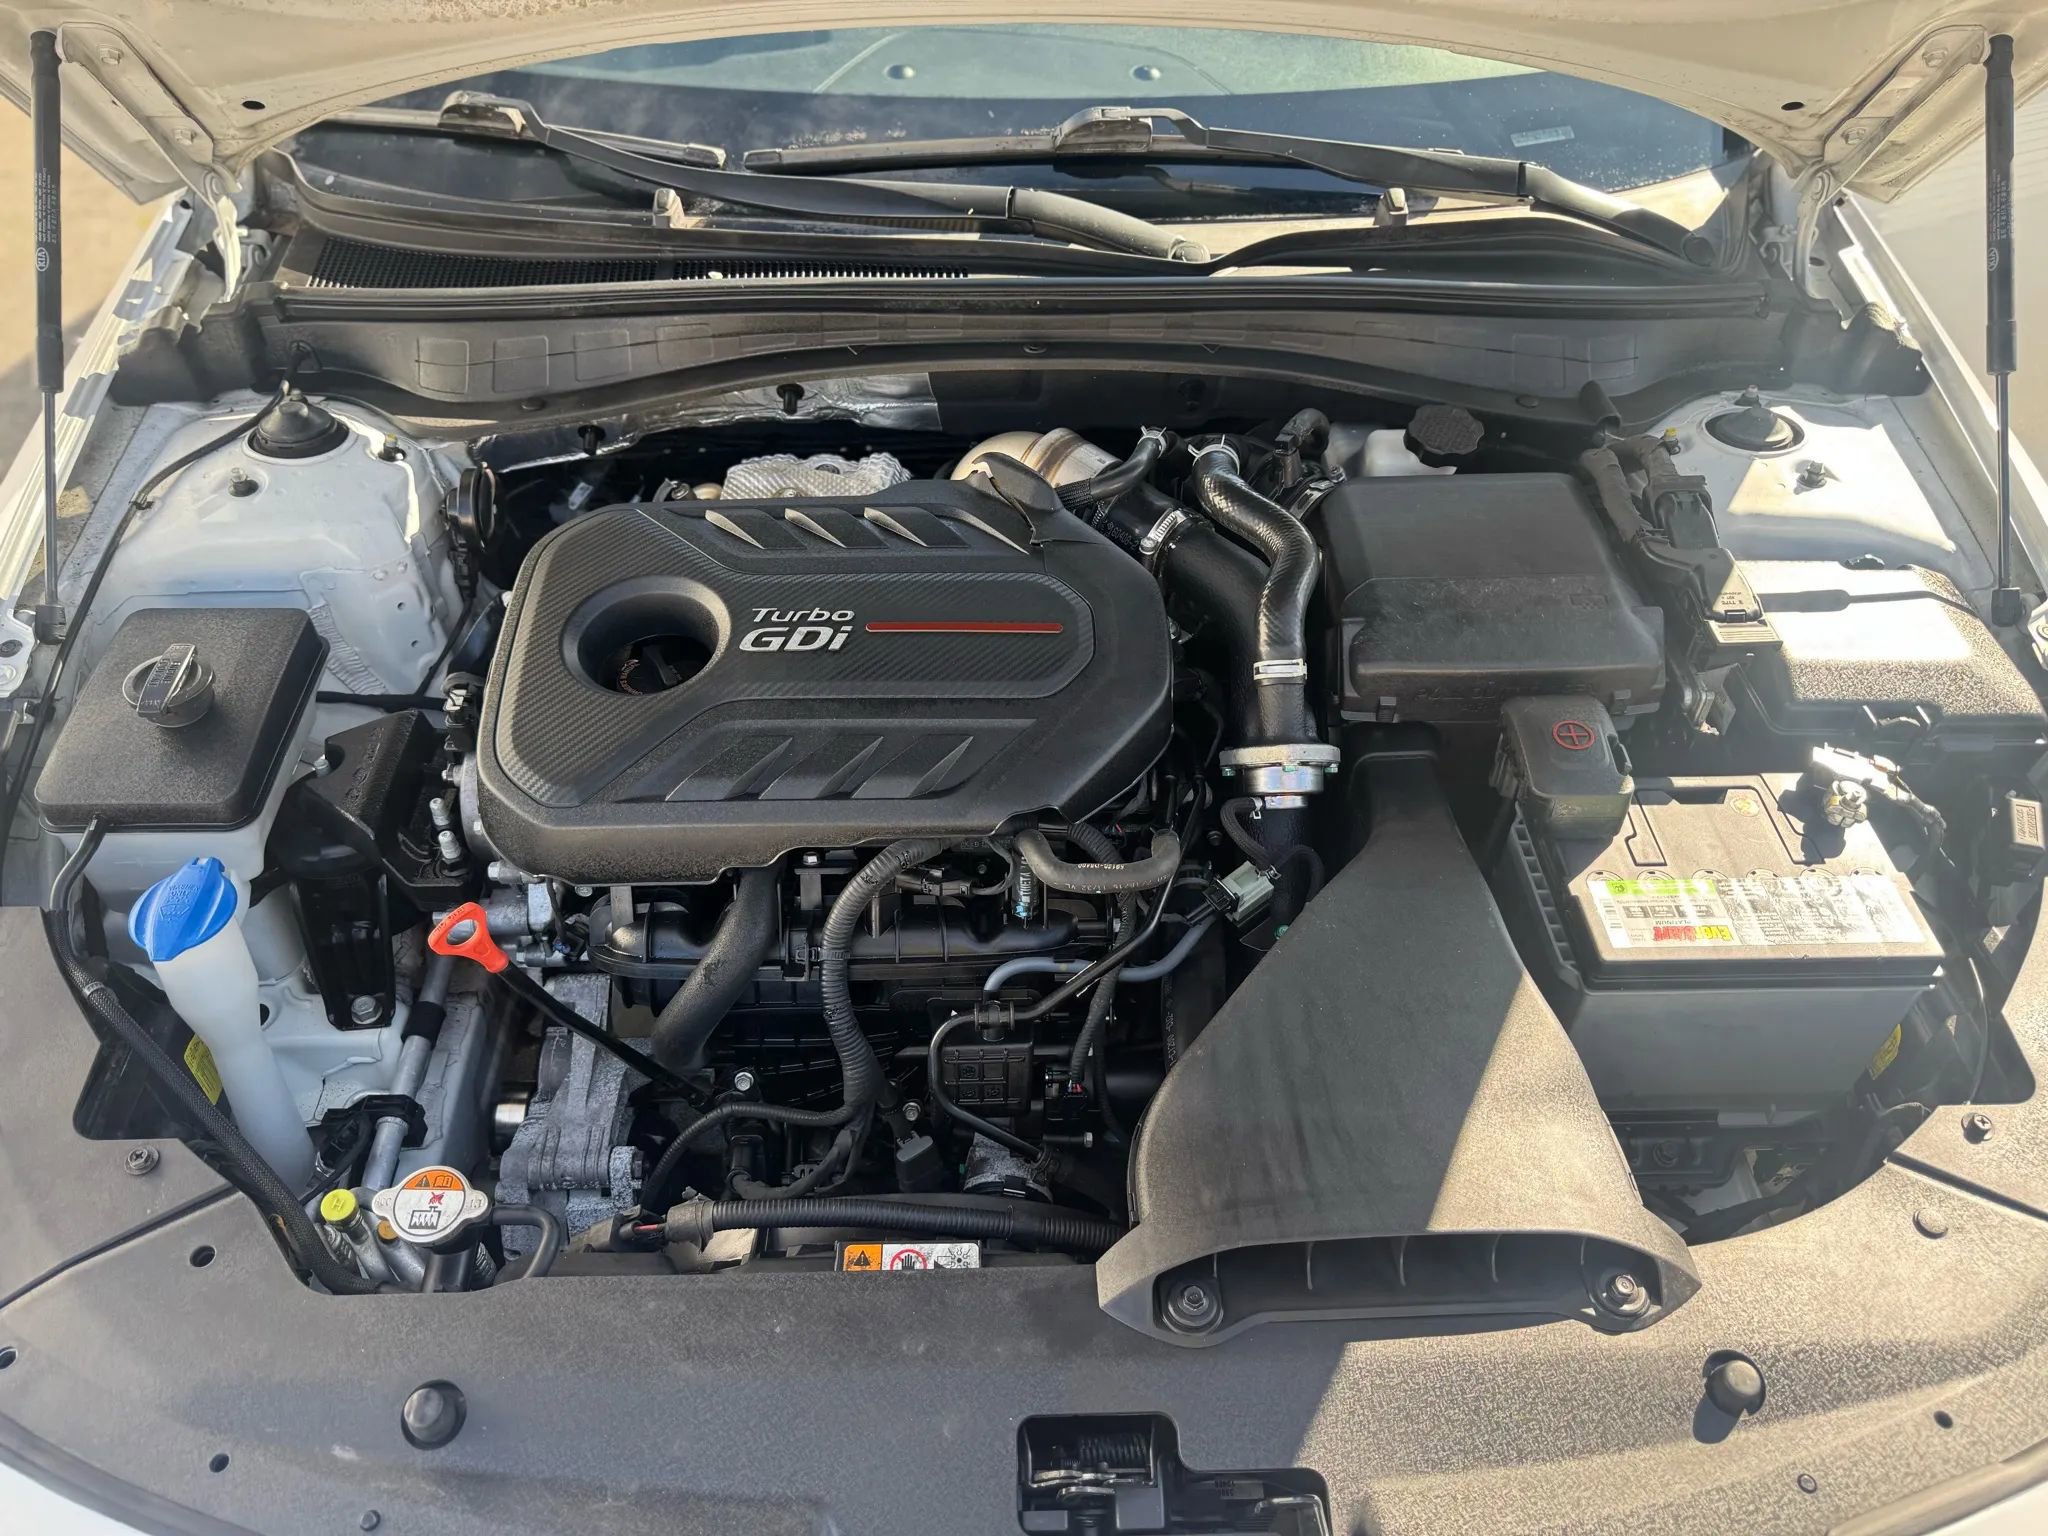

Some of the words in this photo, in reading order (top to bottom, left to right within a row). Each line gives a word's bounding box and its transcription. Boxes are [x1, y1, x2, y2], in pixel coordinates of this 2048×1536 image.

[37, 249, 47, 269] KIA
[751, 607, 856, 623] Turbo
[739, 625, 855, 652] GDi
